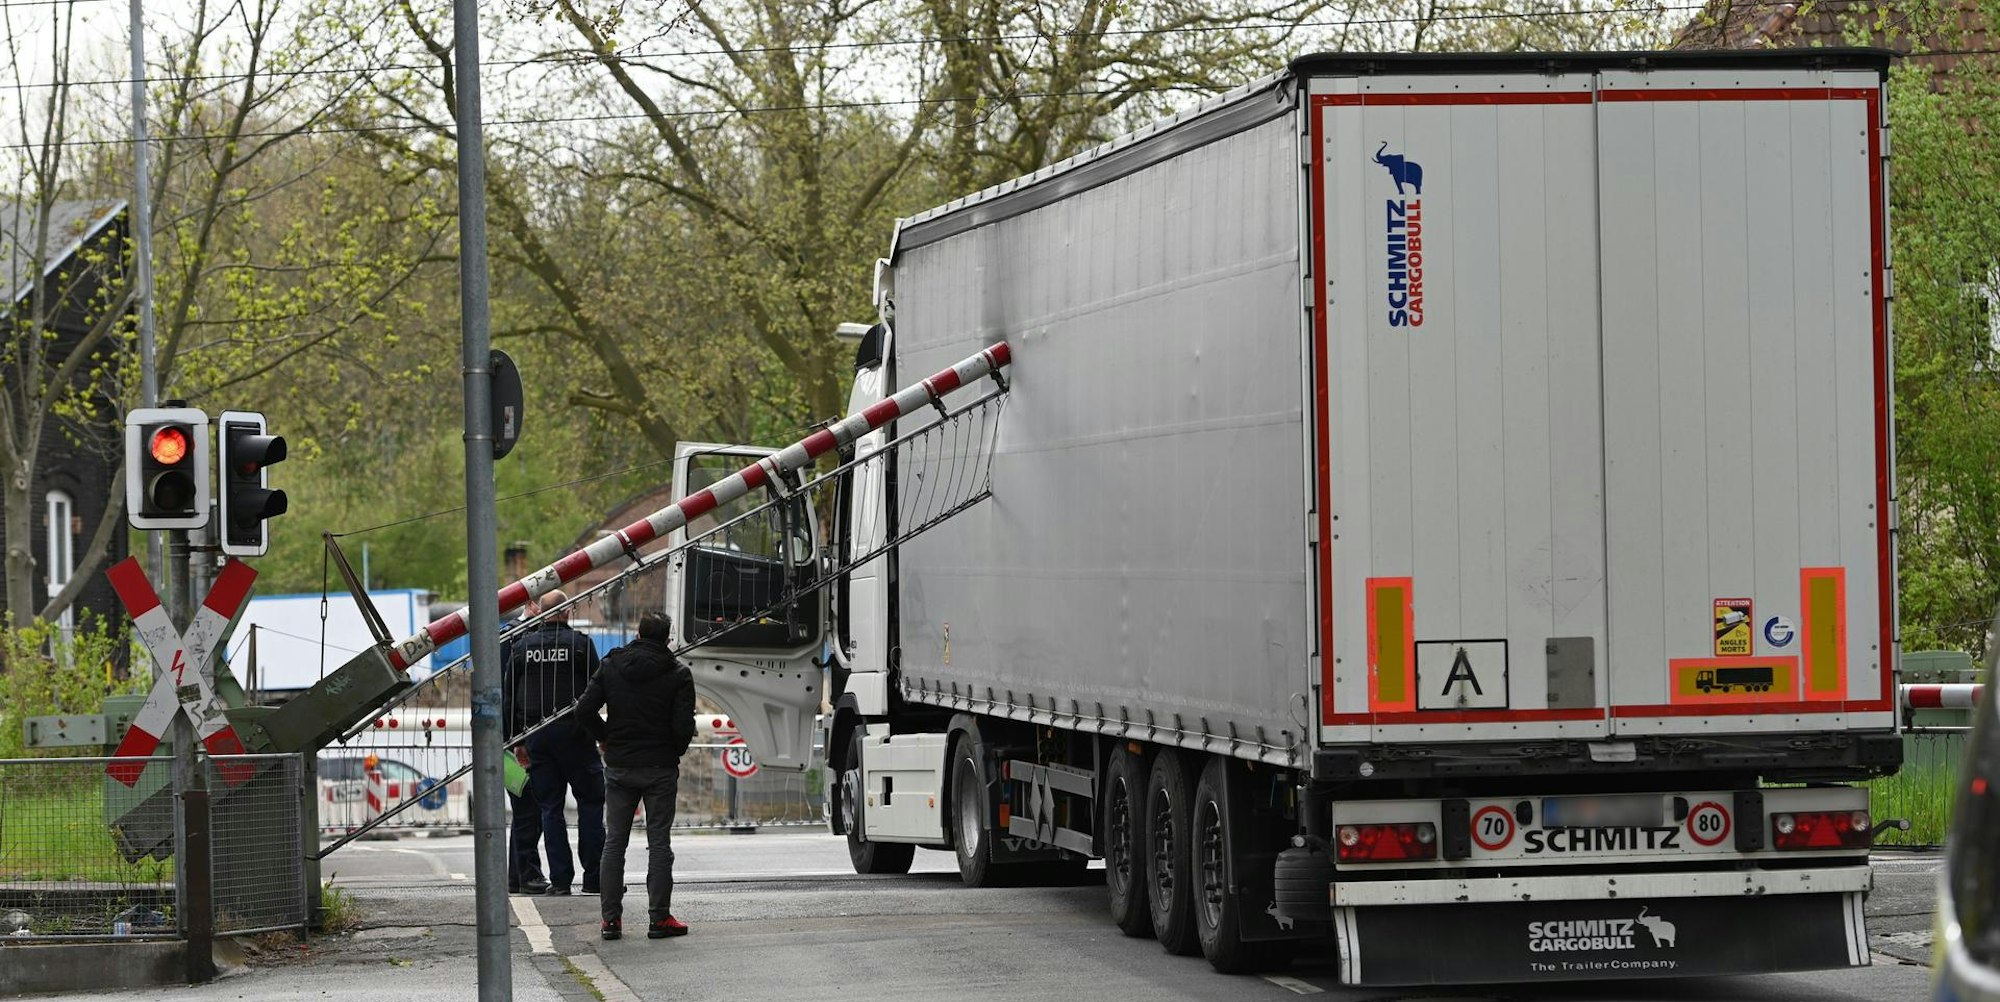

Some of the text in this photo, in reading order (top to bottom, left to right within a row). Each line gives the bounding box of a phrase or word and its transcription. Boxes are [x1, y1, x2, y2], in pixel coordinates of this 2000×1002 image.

[1387, 199, 1408, 327] SCHMITZ
[1406, 199, 1424, 327] CARGOBULL
[525, 647, 570, 665] POLIZEI
[1441, 647, 1483, 696] A
[730, 747, 752, 766] 30
[1483, 817, 1505, 836] 70
[1698, 814, 1721, 832] 80
[1524, 826, 1680, 854] SCHMITZ
[1528, 919, 1635, 939] SCHMITZ
[1528, 936, 1636, 952] CARGOBULL
[1530, 962, 1556, 972] The
